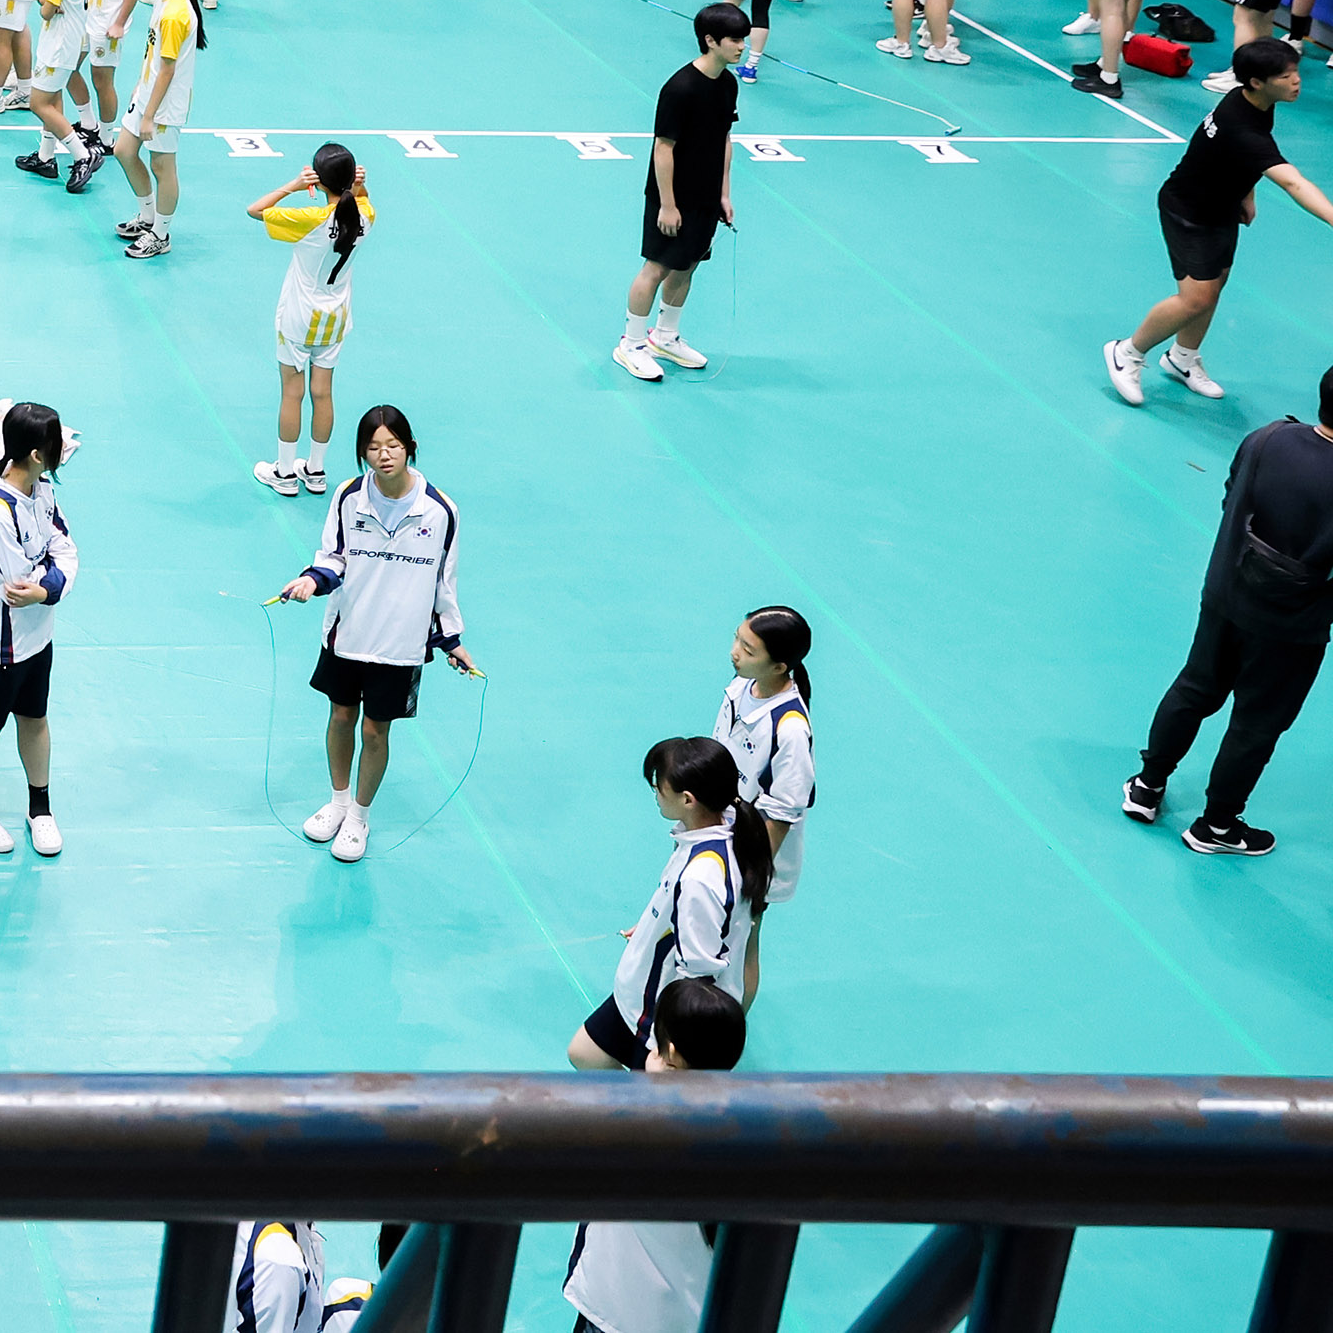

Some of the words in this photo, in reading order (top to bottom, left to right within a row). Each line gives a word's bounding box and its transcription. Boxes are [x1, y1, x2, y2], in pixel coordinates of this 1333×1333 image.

[237, 138, 260, 149] 3
[412, 140, 434, 151] 4
[580, 141, 607, 153] 5
[754, 144, 781, 156] 6
[921, 145, 945, 156] 7
